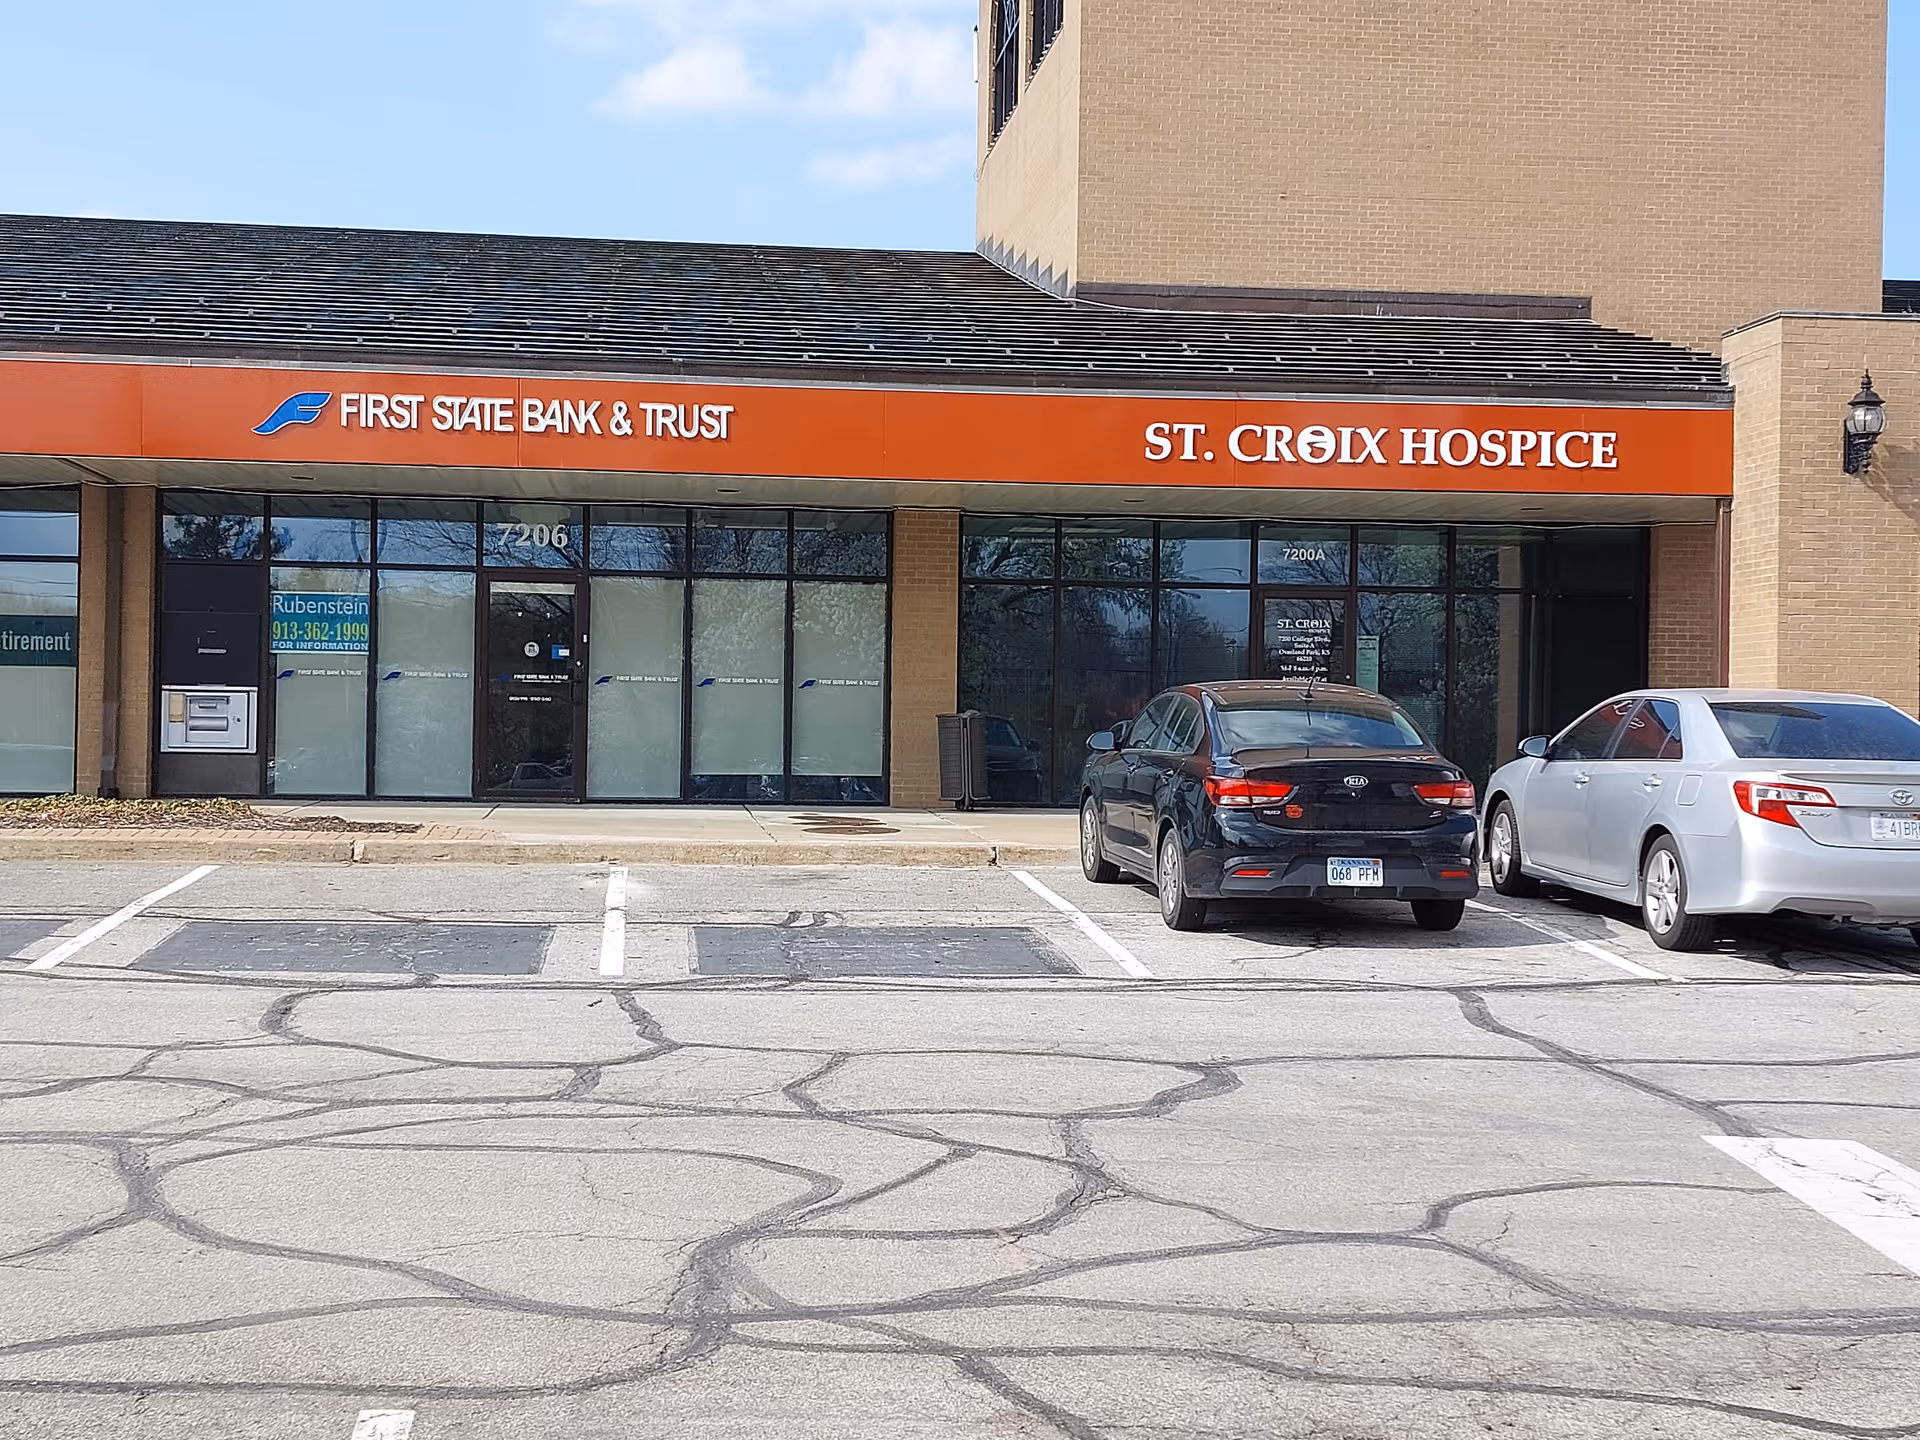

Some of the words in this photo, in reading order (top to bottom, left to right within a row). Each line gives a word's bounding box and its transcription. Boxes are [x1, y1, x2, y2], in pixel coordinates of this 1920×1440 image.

[340, 392, 425, 430] FIRST
[432, 395, 515, 432] STATE
[522, 398, 603, 436] BANK
[609, 400, 634, 436] &
[639, 402, 734, 440] TRUST
[1144, 422, 1214, 462] ST.
[1227, 424, 1389, 465] CROIX
[1398, 428, 1619, 469] HOSPICE
[497, 523, 569, 548] 7206
[1282, 548, 1326, 561] 7200A
[272, 594, 369, 615] Rubenstein
[272, 620, 368, 641] 913-362-1999
[1295, 618, 1332, 629] CROIX
[0, 630, 72, 651] tirement
[272, 641, 294, 650] FOR
[296, 641, 369, 651] INFORMATION
[1349, 777, 1366, 786] KIA
[1890, 821, 1920, 836] 41BR
[1331, 867, 1352, 881] 068
[1358, 867, 1379, 881] PFM
